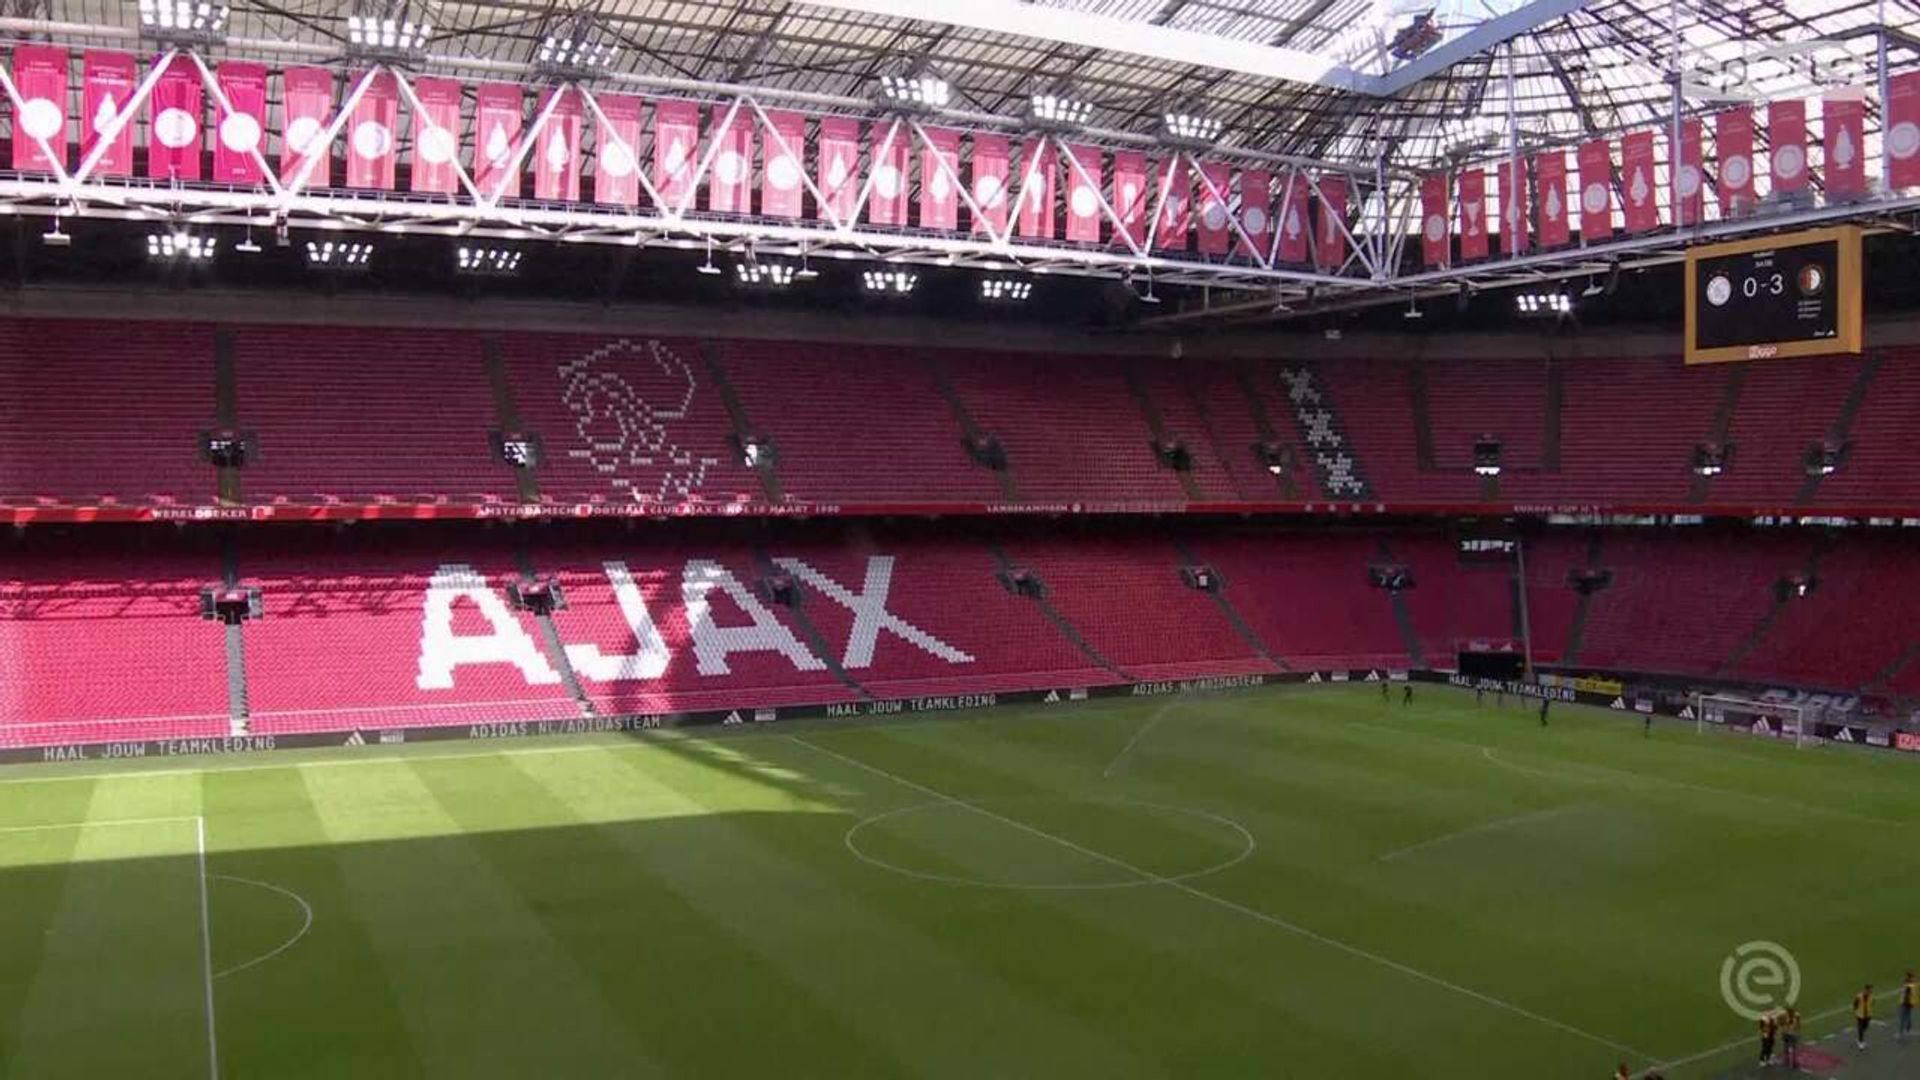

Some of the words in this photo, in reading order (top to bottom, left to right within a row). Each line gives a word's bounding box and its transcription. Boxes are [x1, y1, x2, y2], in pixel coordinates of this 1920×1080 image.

[416, 555, 975, 689] AJAX
[826, 702, 861, 718] HAAL
[868, 700, 902, 715] JOUW
[910, 694, 997, 713] TEAMKLEDING
[43, 744, 88, 761] HAAL
[101, 742, 146, 759] JOUW
[158, 735, 277, 757] TEAMKLEDING
